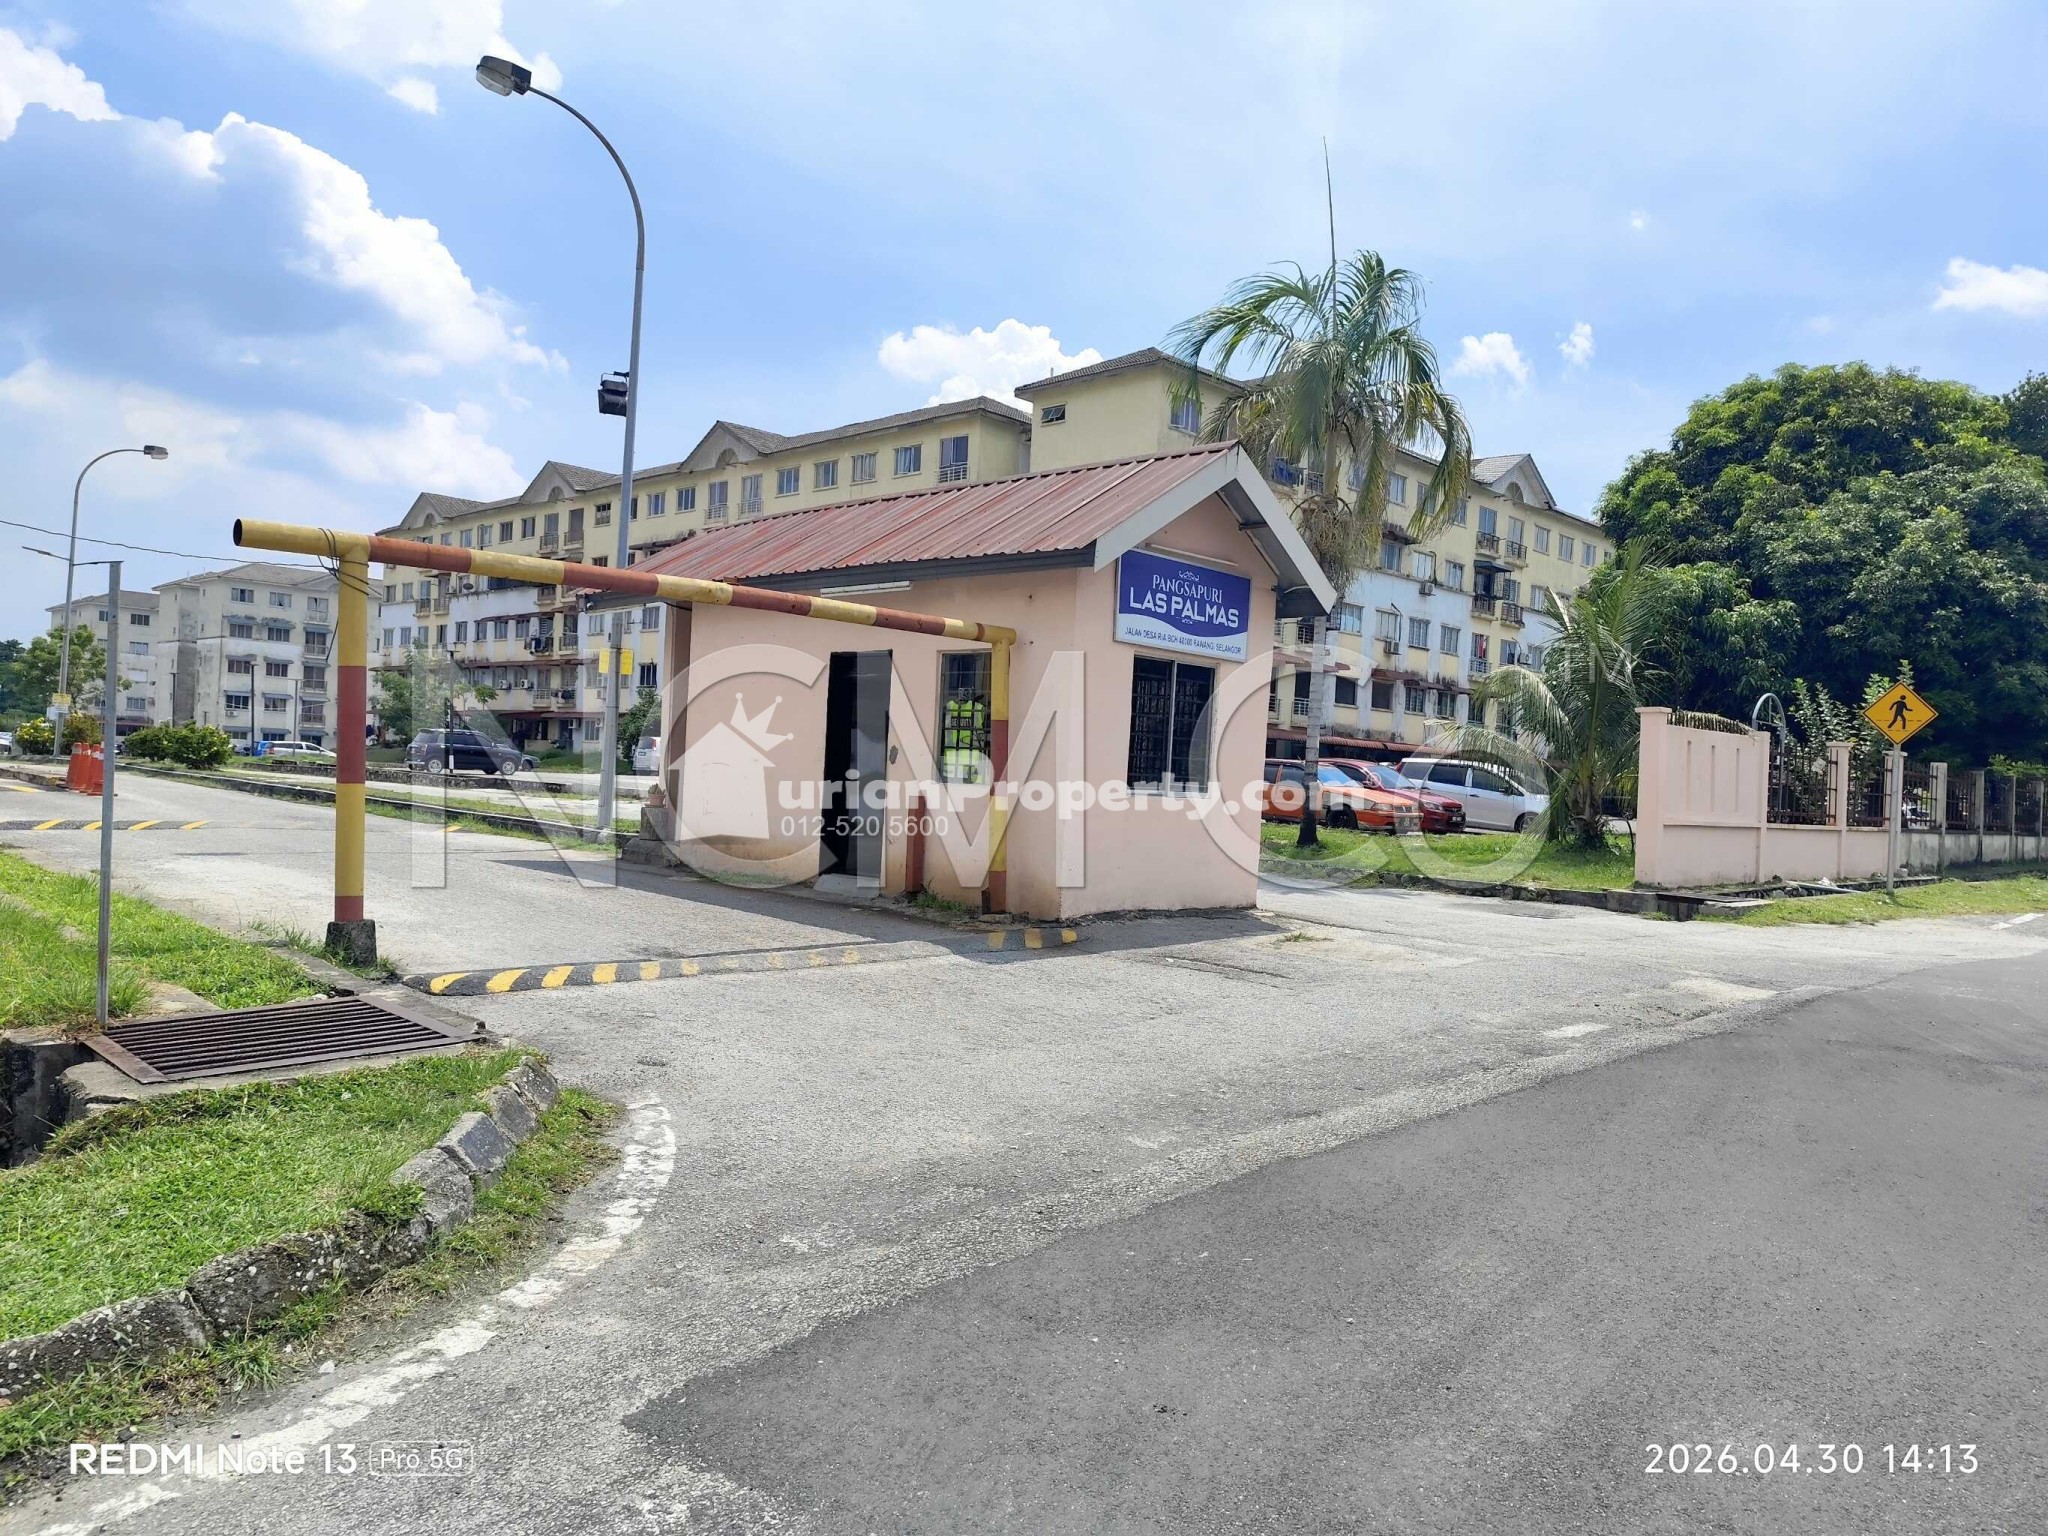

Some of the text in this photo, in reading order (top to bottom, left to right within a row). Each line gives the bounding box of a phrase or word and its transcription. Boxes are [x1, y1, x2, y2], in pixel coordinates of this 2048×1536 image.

[1153, 574, 1222, 604] PANGSAPURI
[1130, 587, 1239, 628] LAS PALMAS
[1125, 626, 1142, 637] JALAN
[1143, 629, 1157, 640] DESA
[1216, 642, 1242, 655] SELANGOR
